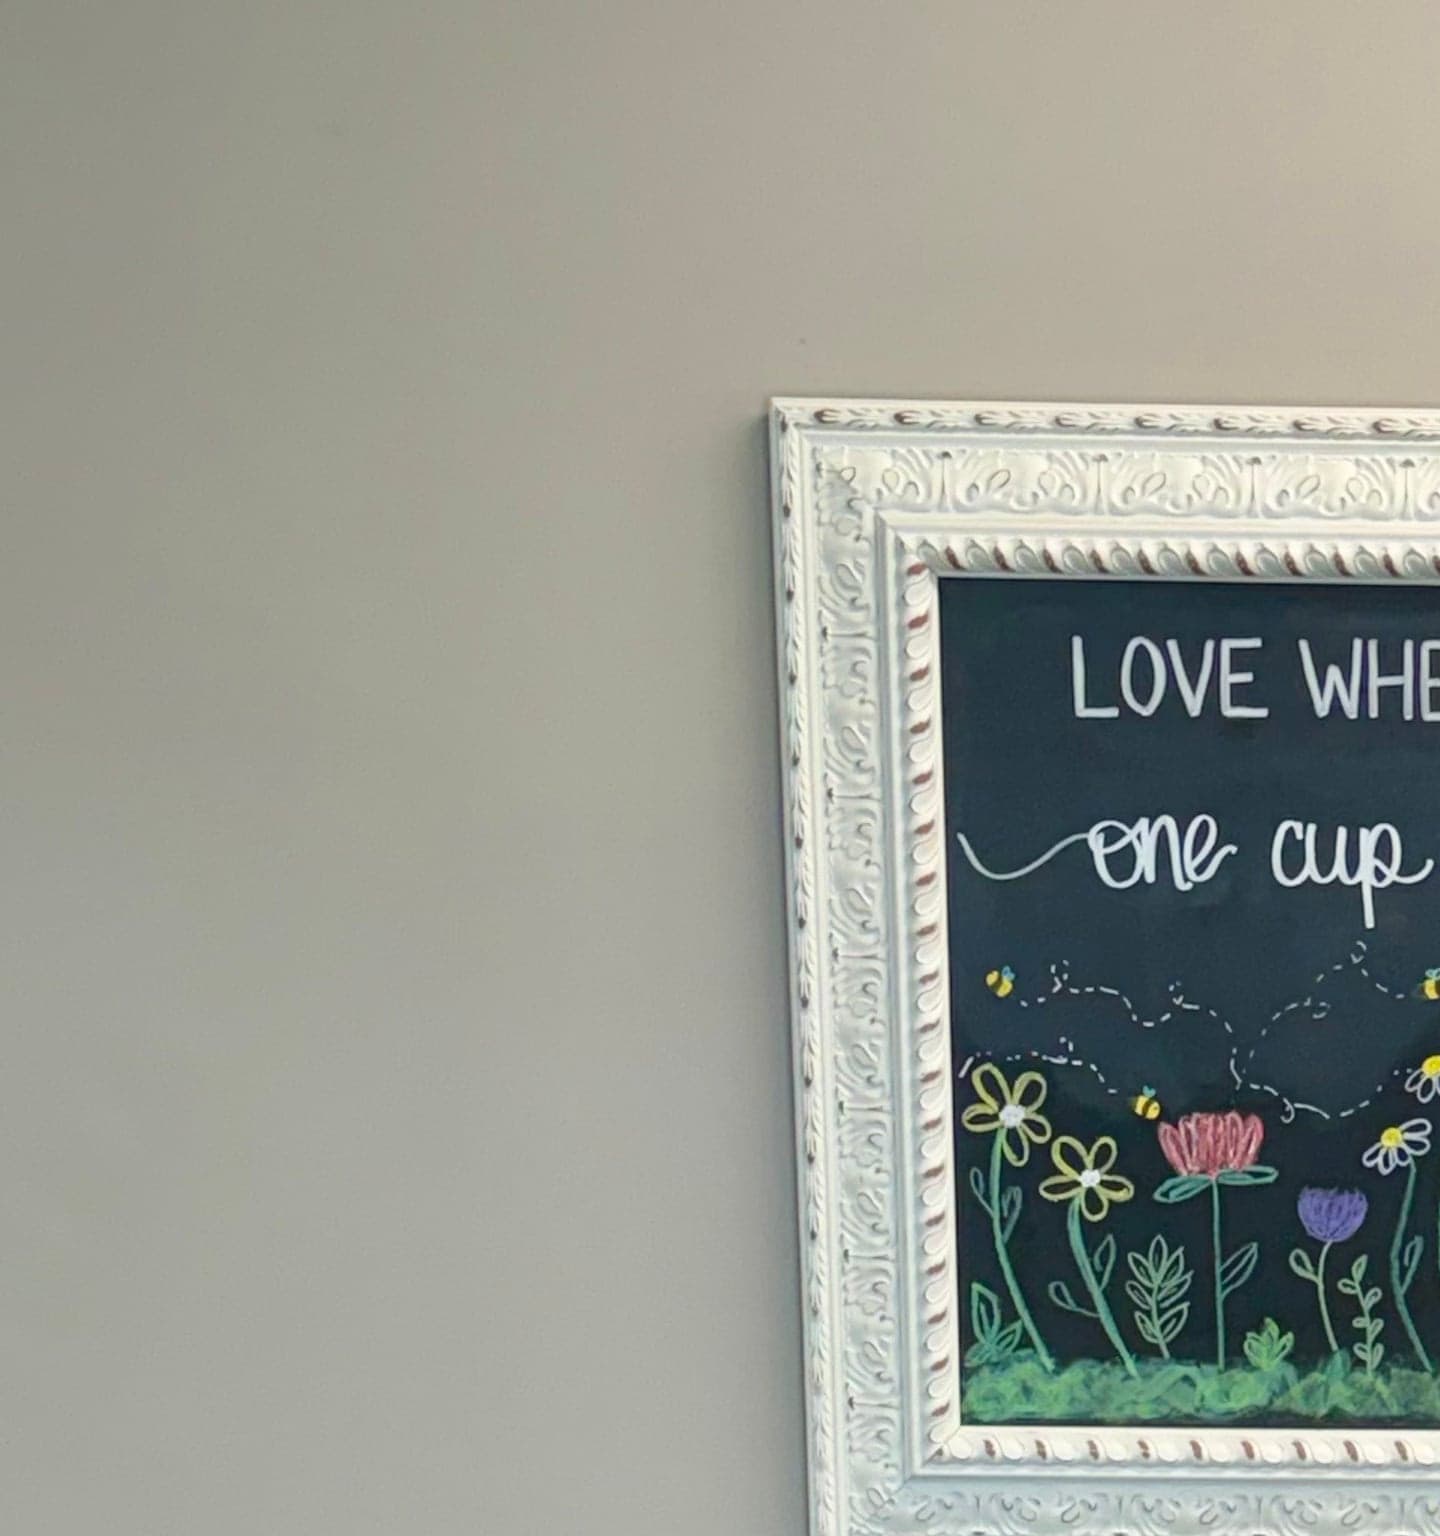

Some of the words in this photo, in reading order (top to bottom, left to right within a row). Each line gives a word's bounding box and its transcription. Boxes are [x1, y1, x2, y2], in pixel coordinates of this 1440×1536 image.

[1072, 635, 1269, 718] LOVE
[1087, 813, 1238, 891] one
[1271, 822, 1434, 929] cup
